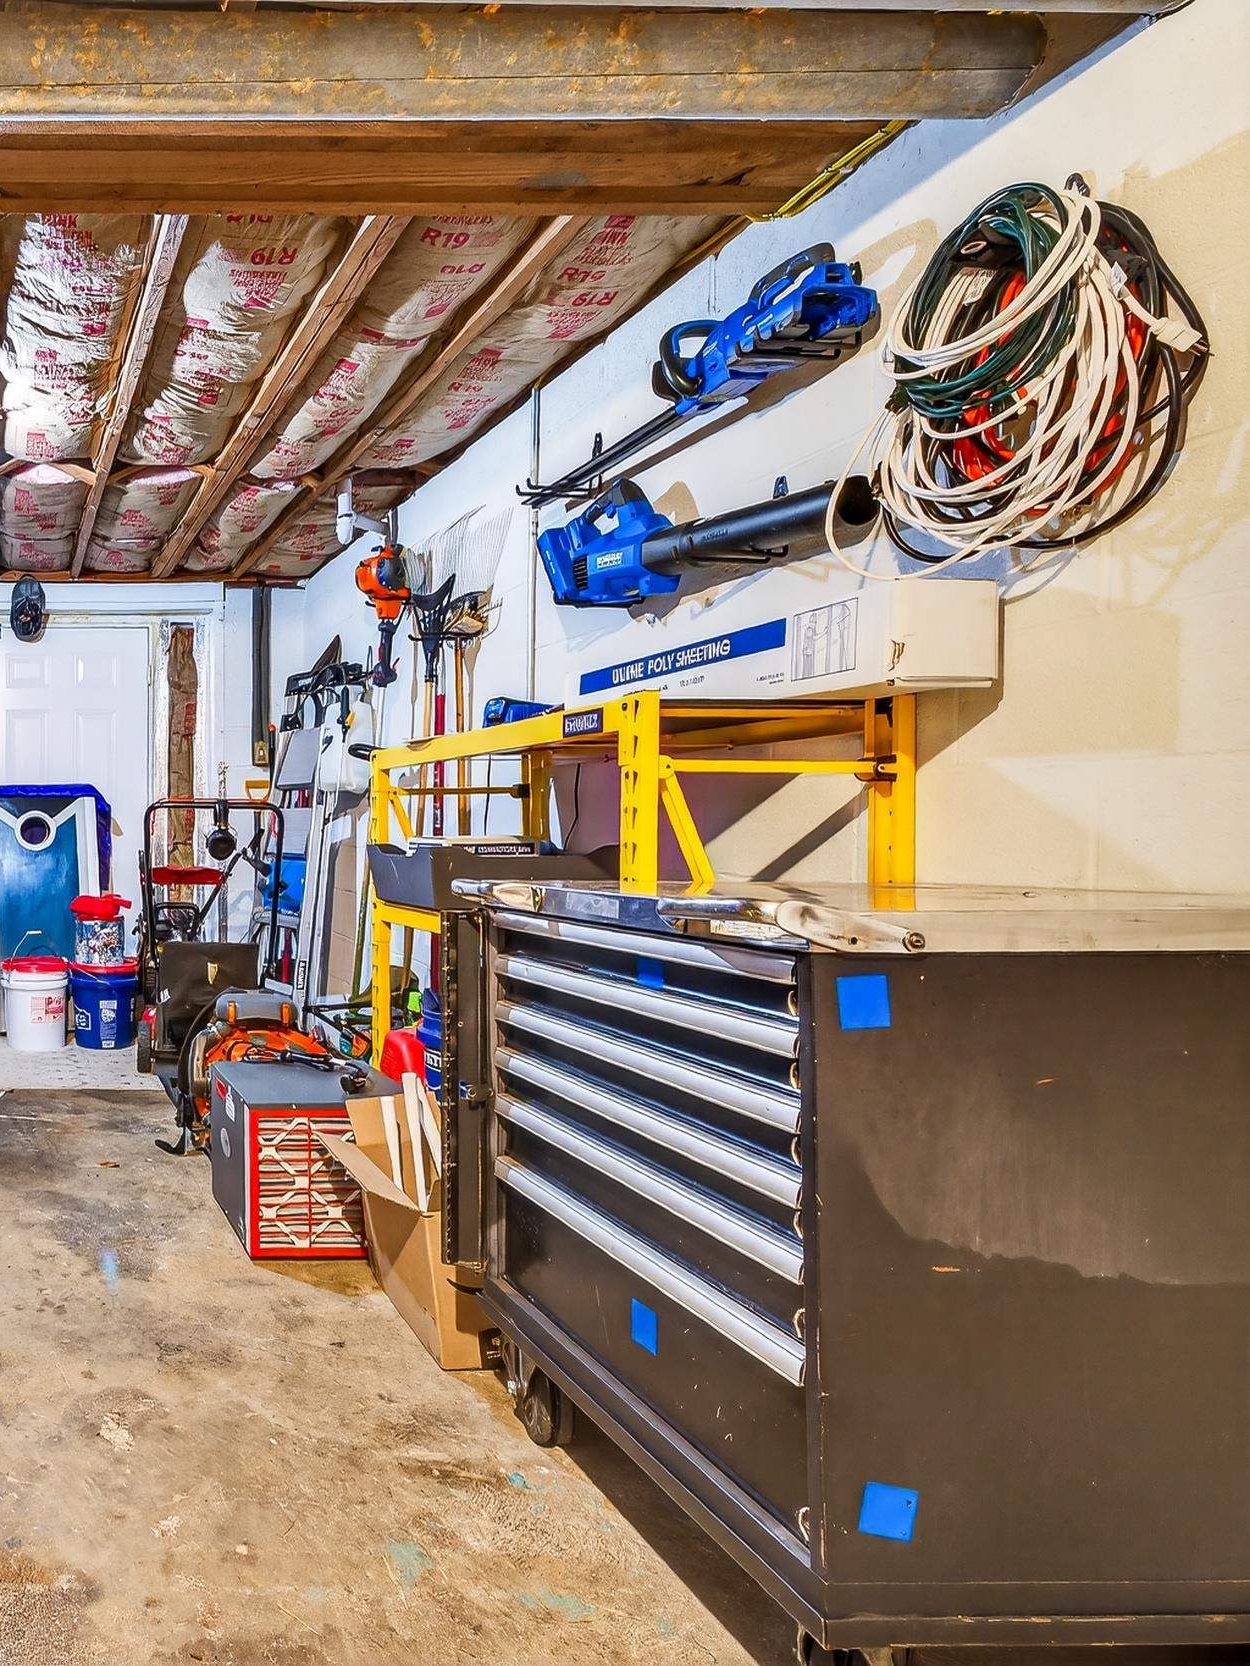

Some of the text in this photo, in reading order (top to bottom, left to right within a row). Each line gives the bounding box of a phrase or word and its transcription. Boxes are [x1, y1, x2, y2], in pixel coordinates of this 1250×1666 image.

[419, 226, 470, 249] R19
[250, 247, 298, 266] R19
[647, 653, 675, 675] POLY
[675, 639, 731, 668] SHEETING
